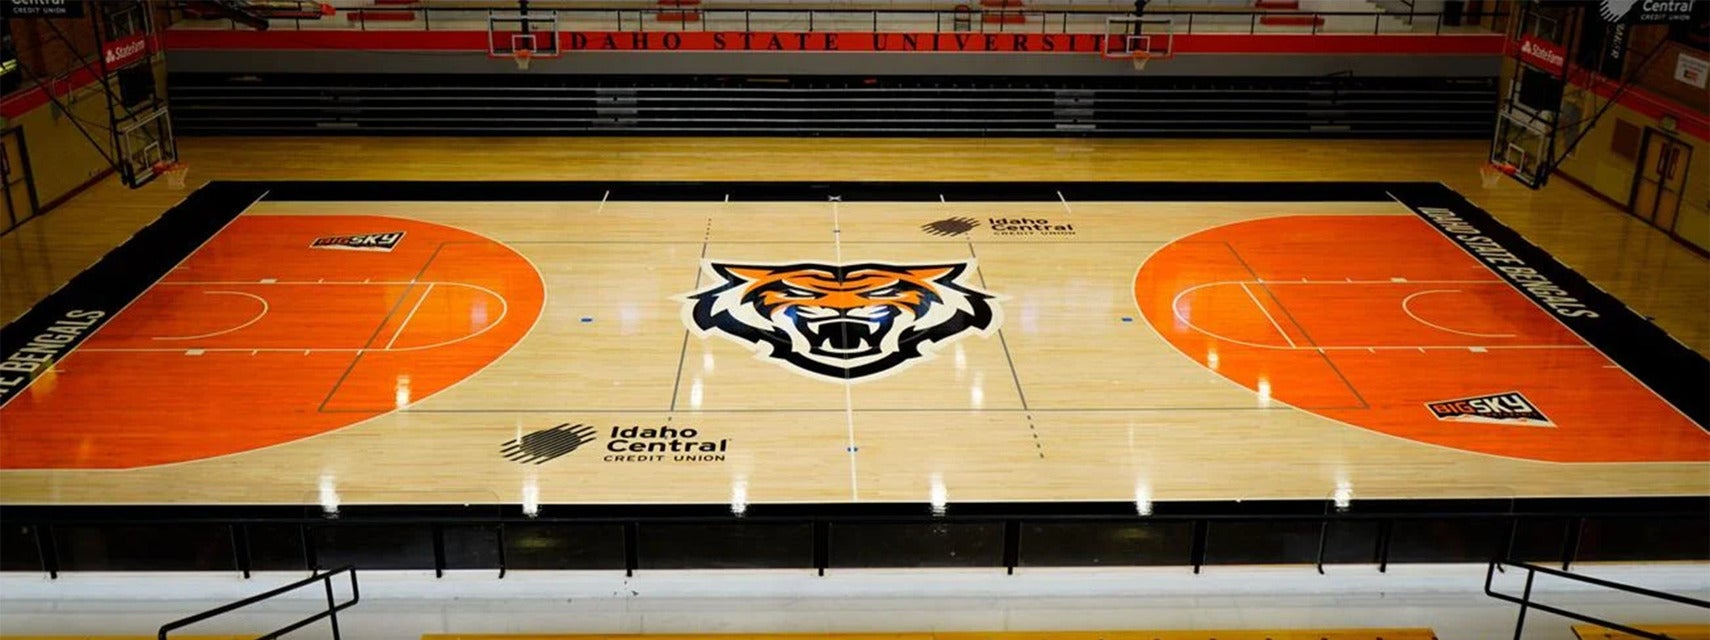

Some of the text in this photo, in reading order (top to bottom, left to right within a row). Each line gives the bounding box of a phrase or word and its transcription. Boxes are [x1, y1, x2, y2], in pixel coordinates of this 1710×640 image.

[1643, 0, 1694, 12] Central
[713, 32, 839, 50] STATE
[1417, 207, 1600, 318] IDAHO STATE BENGALS
[0, 310, 106, 372] BENGALS
[611, 426, 698, 438] Idaho
[607, 439, 728, 452] Central
